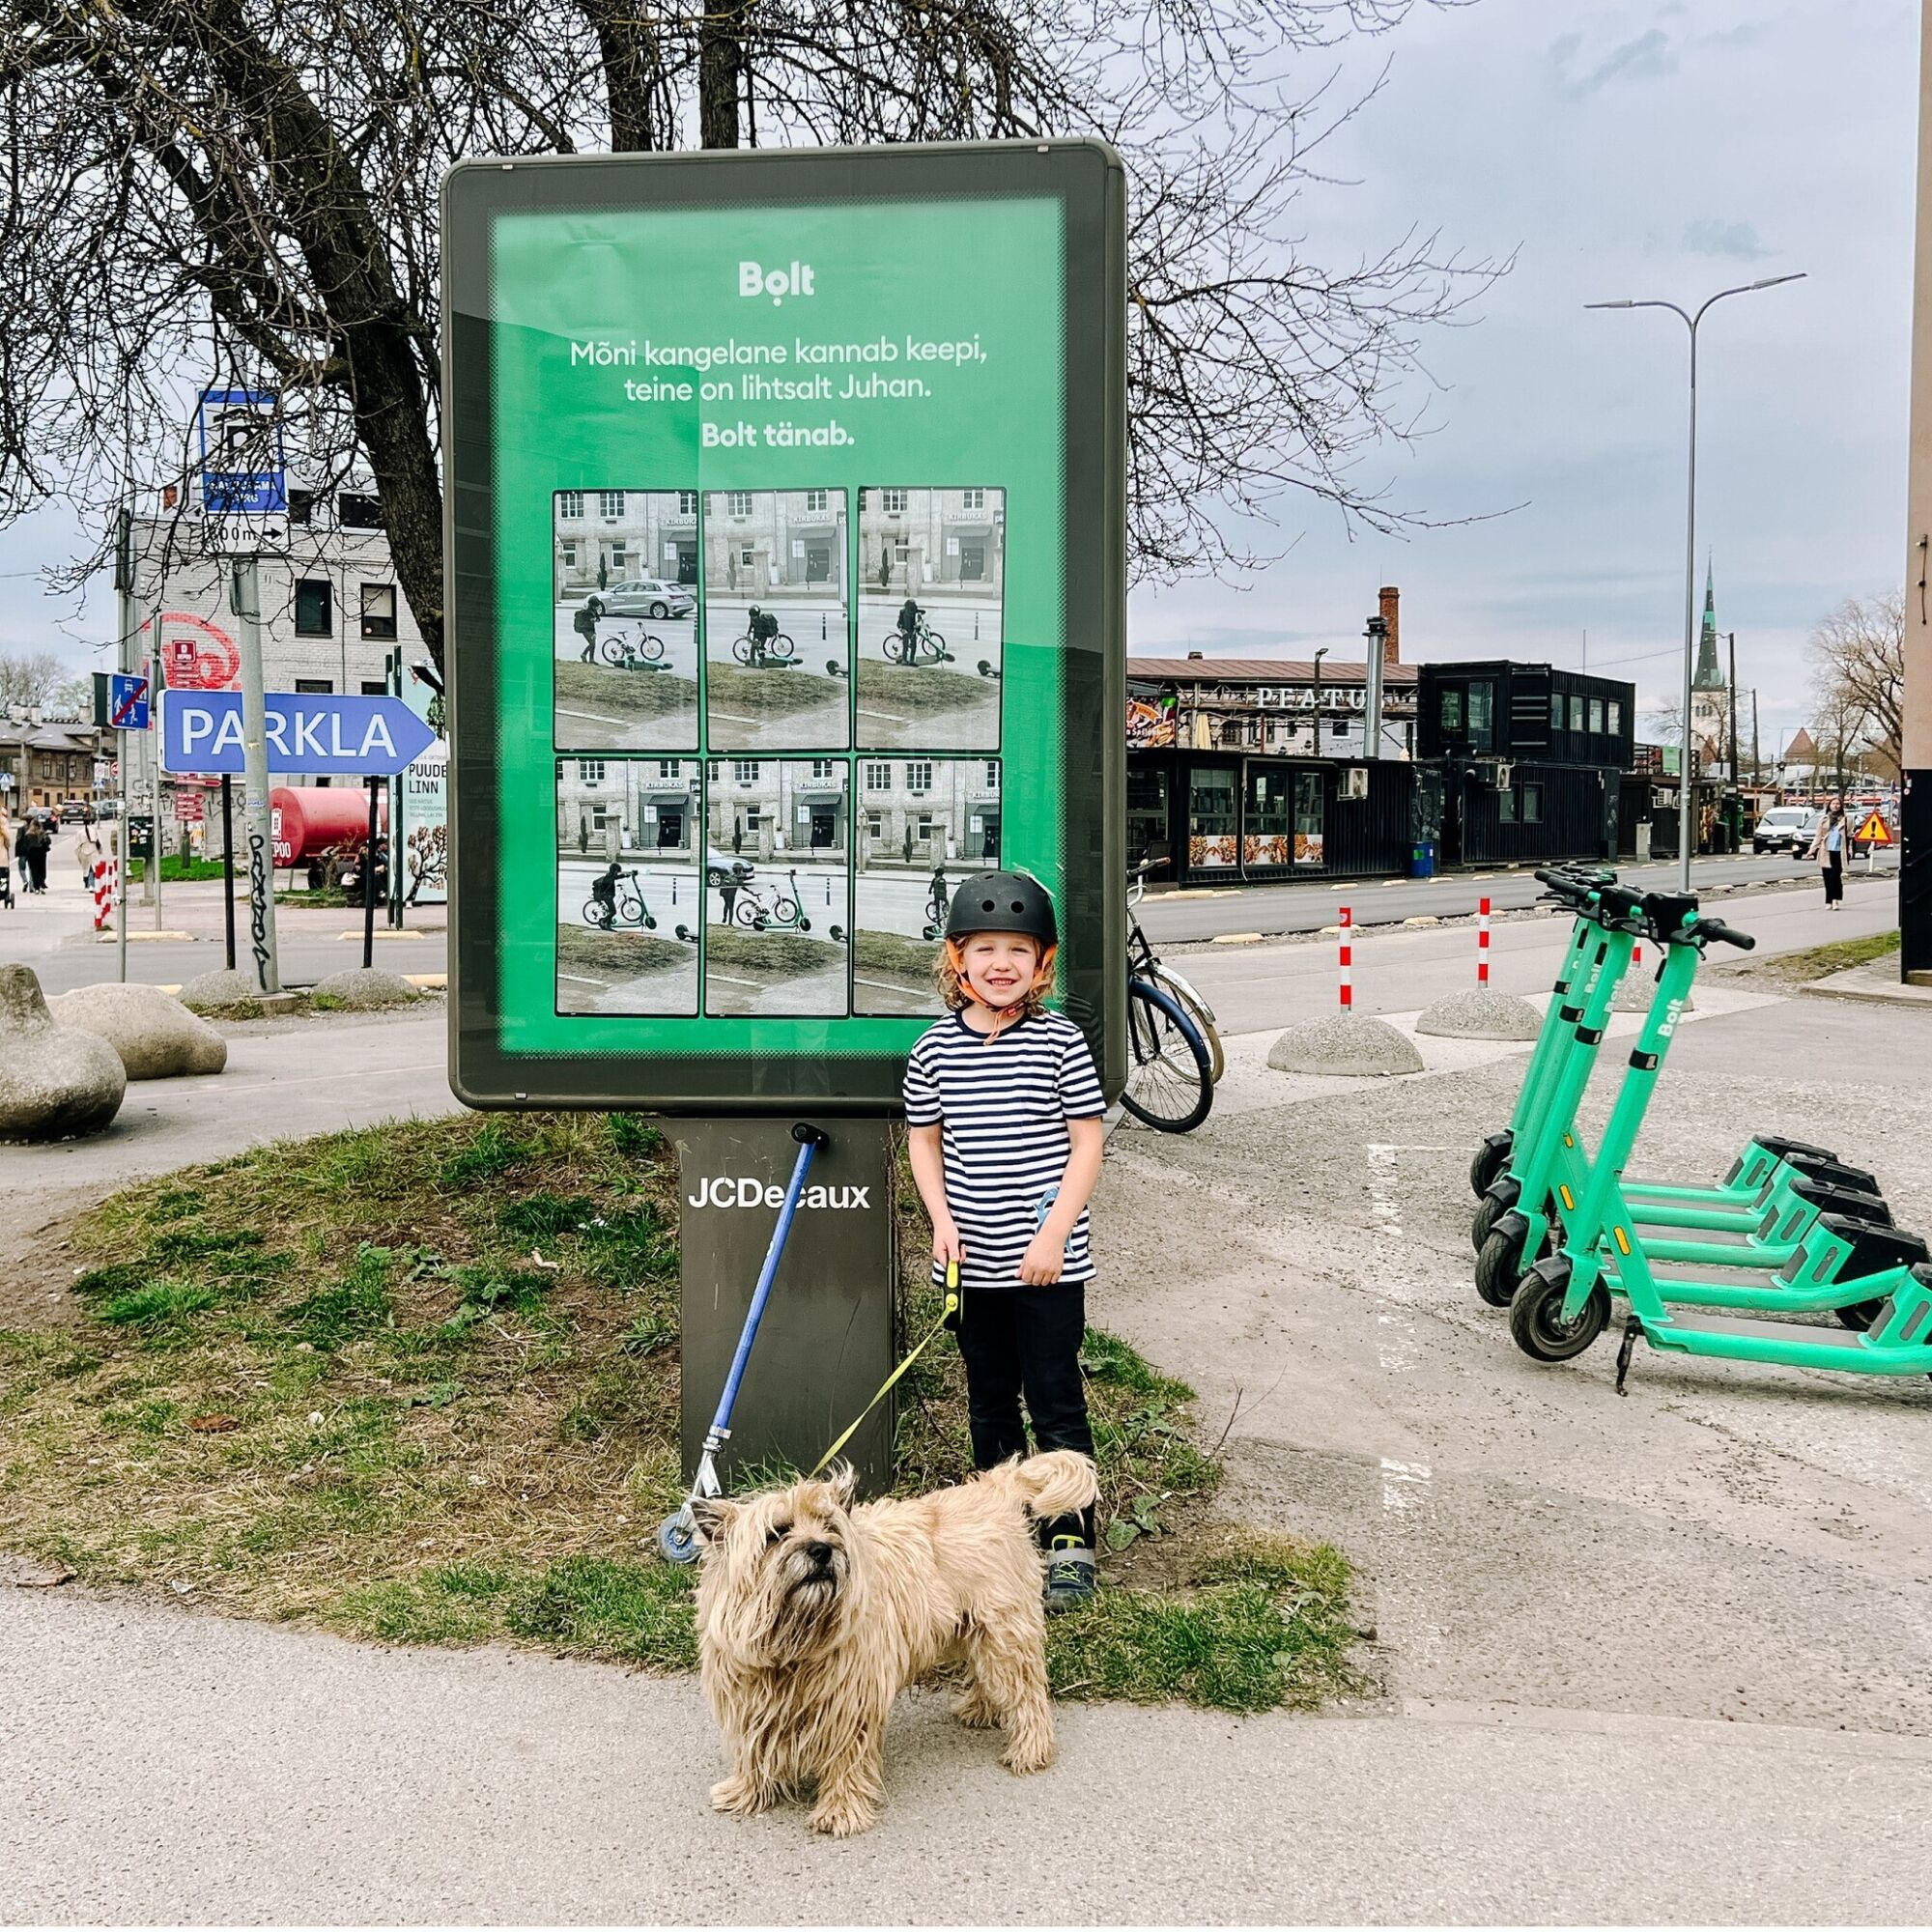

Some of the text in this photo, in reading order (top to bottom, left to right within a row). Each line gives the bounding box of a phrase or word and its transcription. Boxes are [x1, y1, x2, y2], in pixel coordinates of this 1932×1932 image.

[739, 260, 814, 306] Bolt
[570, 333, 987, 372] Mõni kangelane kannab keepi,
[624, 373, 931, 402] teine on lihtsalt Juhan.
[702, 420, 855, 448] Bolt tänab.
[1256, 687, 1383, 710] PEATU
[182, 708, 398, 758] PARKLA
[409, 780, 439, 794] LINN
[1657, 998, 1685, 1037] Bolt
